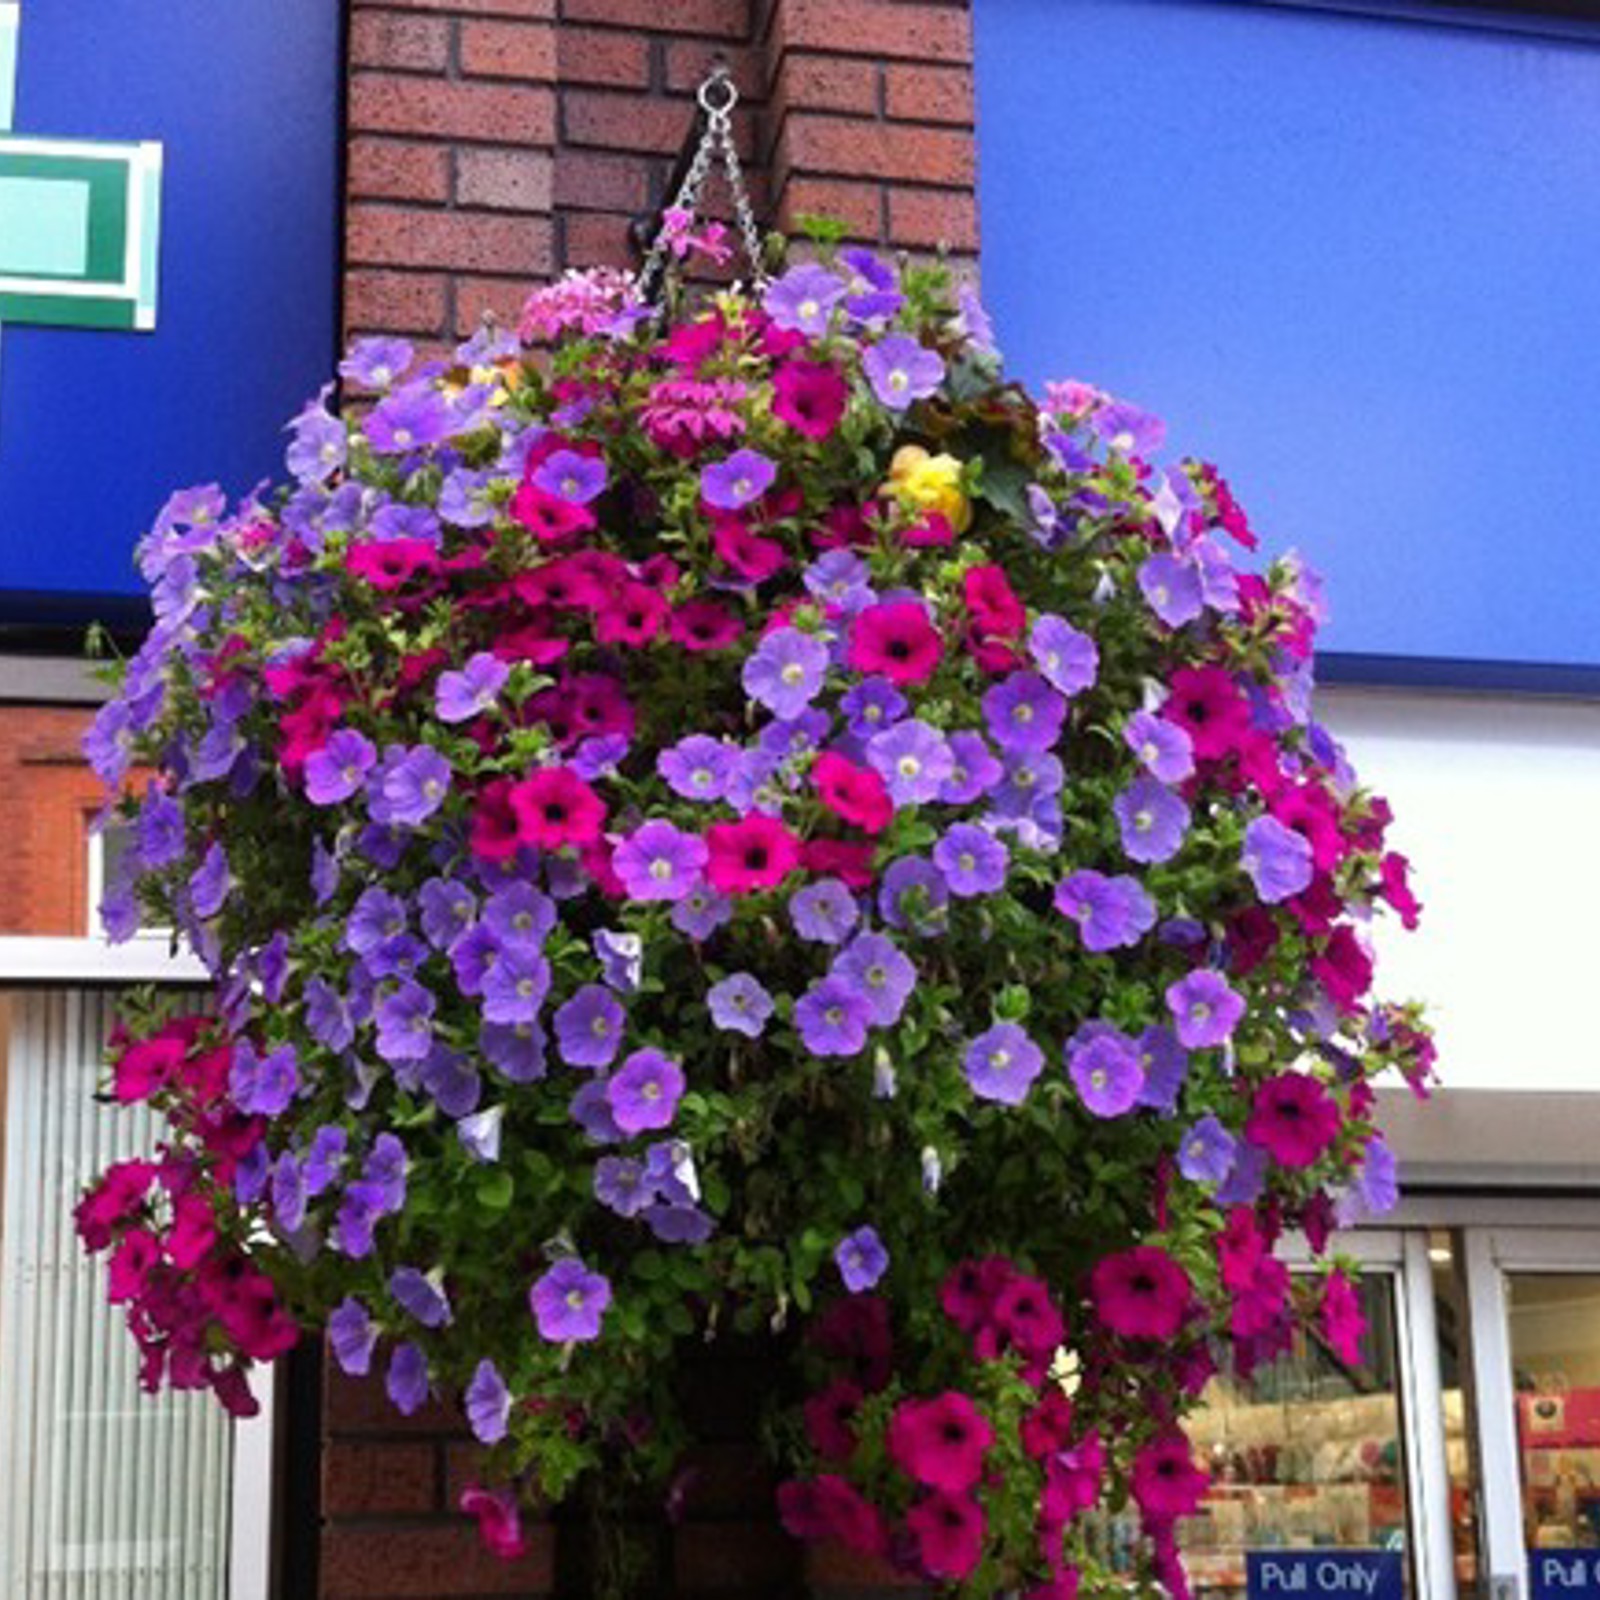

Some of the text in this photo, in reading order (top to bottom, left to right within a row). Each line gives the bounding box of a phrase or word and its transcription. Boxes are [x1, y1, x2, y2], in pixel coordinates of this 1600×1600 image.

[1261, 1561, 1379, 1595] Pull Only
[1543, 1559, 1587, 1587] Pull
